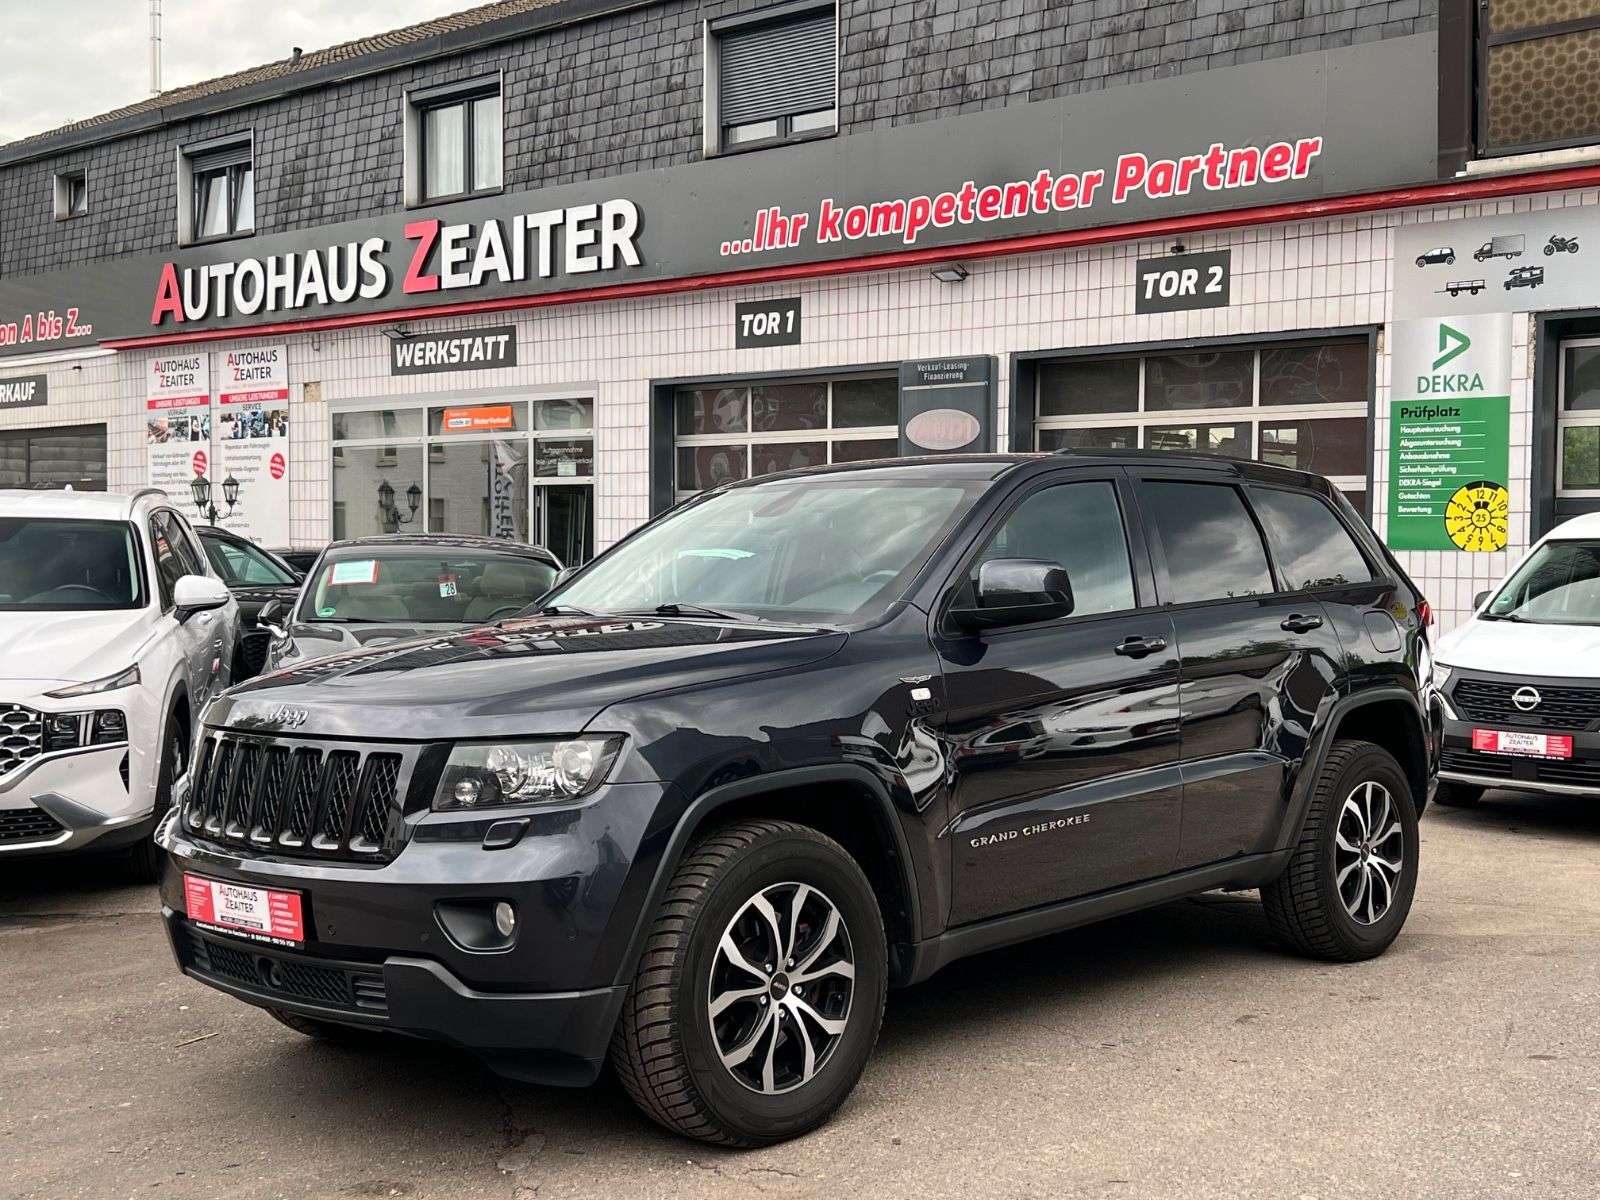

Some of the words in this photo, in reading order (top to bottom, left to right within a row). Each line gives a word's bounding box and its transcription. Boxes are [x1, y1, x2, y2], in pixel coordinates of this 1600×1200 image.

[720, 207, 809, 256] ...Ihr
[817, 166, 1104, 243] kompetenter
[1112, 136, 1322, 204] Partner
[151, 237, 388, 325] AUTOHAUS
[402, 198, 641, 295] ZEAITER
[1142, 268, 1199, 299] TOR
[1204, 266, 1223, 293] 2
[20, 314, 33, 343] A
[37, 310, 63, 341] bis
[741, 312, 780, 337] TOR
[786, 310, 795, 333] 1
[227, 350, 278, 366] AUTOHAUS
[396, 335, 509, 367] WERKSTATT
[154, 358, 200, 374] AUTOHAUS
[160, 374, 194, 388] ZEAITER
[234, 367, 272, 381] ZEAITER
[923, 372, 963, 381] Finanzierung
[1417, 373, 1484, 394] DEKRA
[1400, 405, 1460, 420] Prüfplatz
[1400, 424, 1461, 434] Hauptuntersuchung
[1400, 438, 1461, 448] Abgasuntersuchung
[1399, 464, 1457, 474] Sicherheitsprüfung
[1398, 491, 1430, 499] Gutachten
[1476, 489, 1485, 499] 12
[1398, 505, 1432, 514] Bewertung
[1475, 514, 1487, 523] 25
[445, 583, 456, 595] 28
[268, 704, 309, 729] Jeep
[970, 830, 1018, 848] GRAND
[1022, 814, 1091, 836] CHEROKEE
[219, 883, 258, 902] AUTOHAUS
[224, 898, 255, 913] ZEAITER
